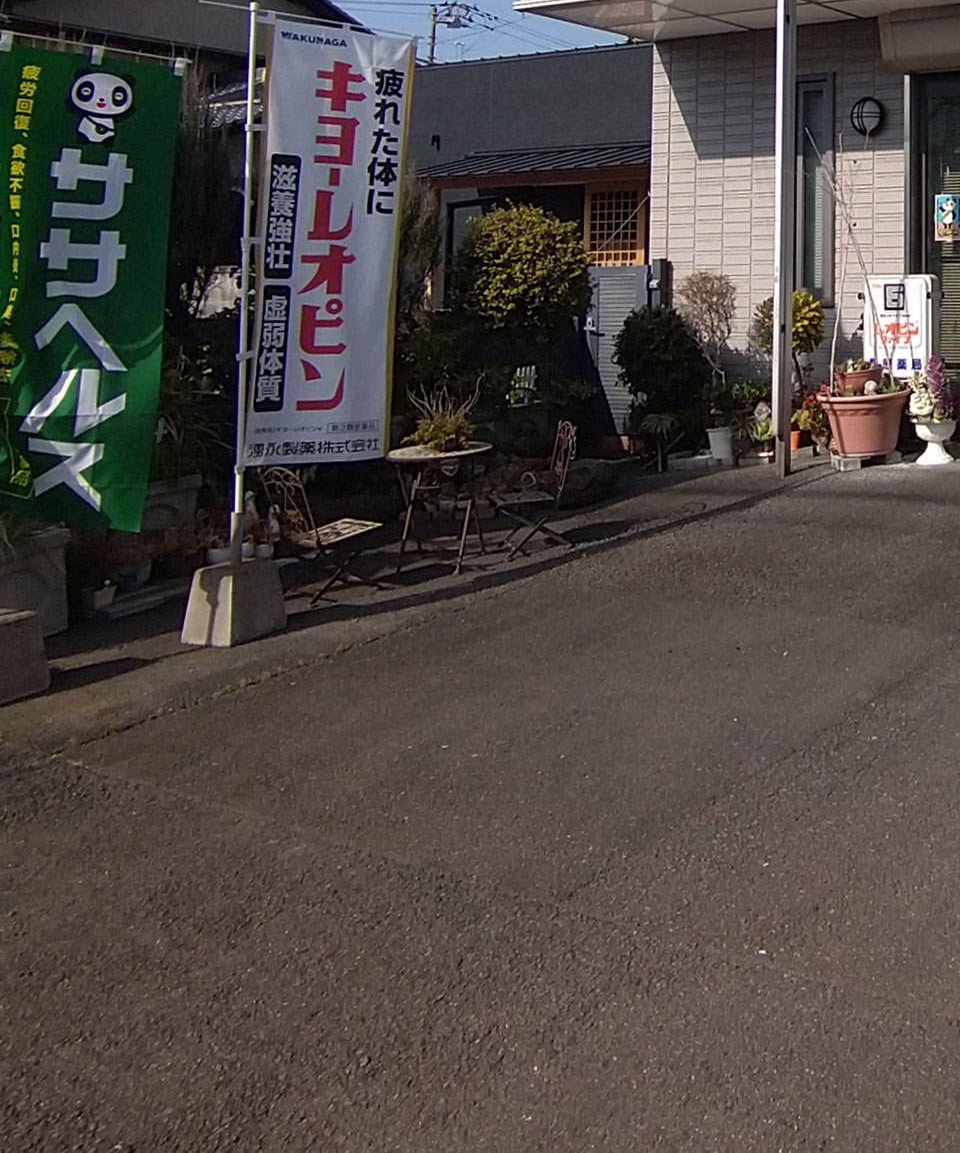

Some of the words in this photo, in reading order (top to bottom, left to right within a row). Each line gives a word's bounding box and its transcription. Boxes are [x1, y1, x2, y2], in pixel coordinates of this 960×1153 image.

[281, 31, 347, 47] WAKUNAGA
[366, 69, 404, 215] 疲れた体に
[265, 164, 298, 270] 滋養強壮
[19, 148, 133, 512] ササヘルス
[256, 295, 288, 402] 虚弱体質
[248, 438, 379, 458] 湧永製薬株式会社
